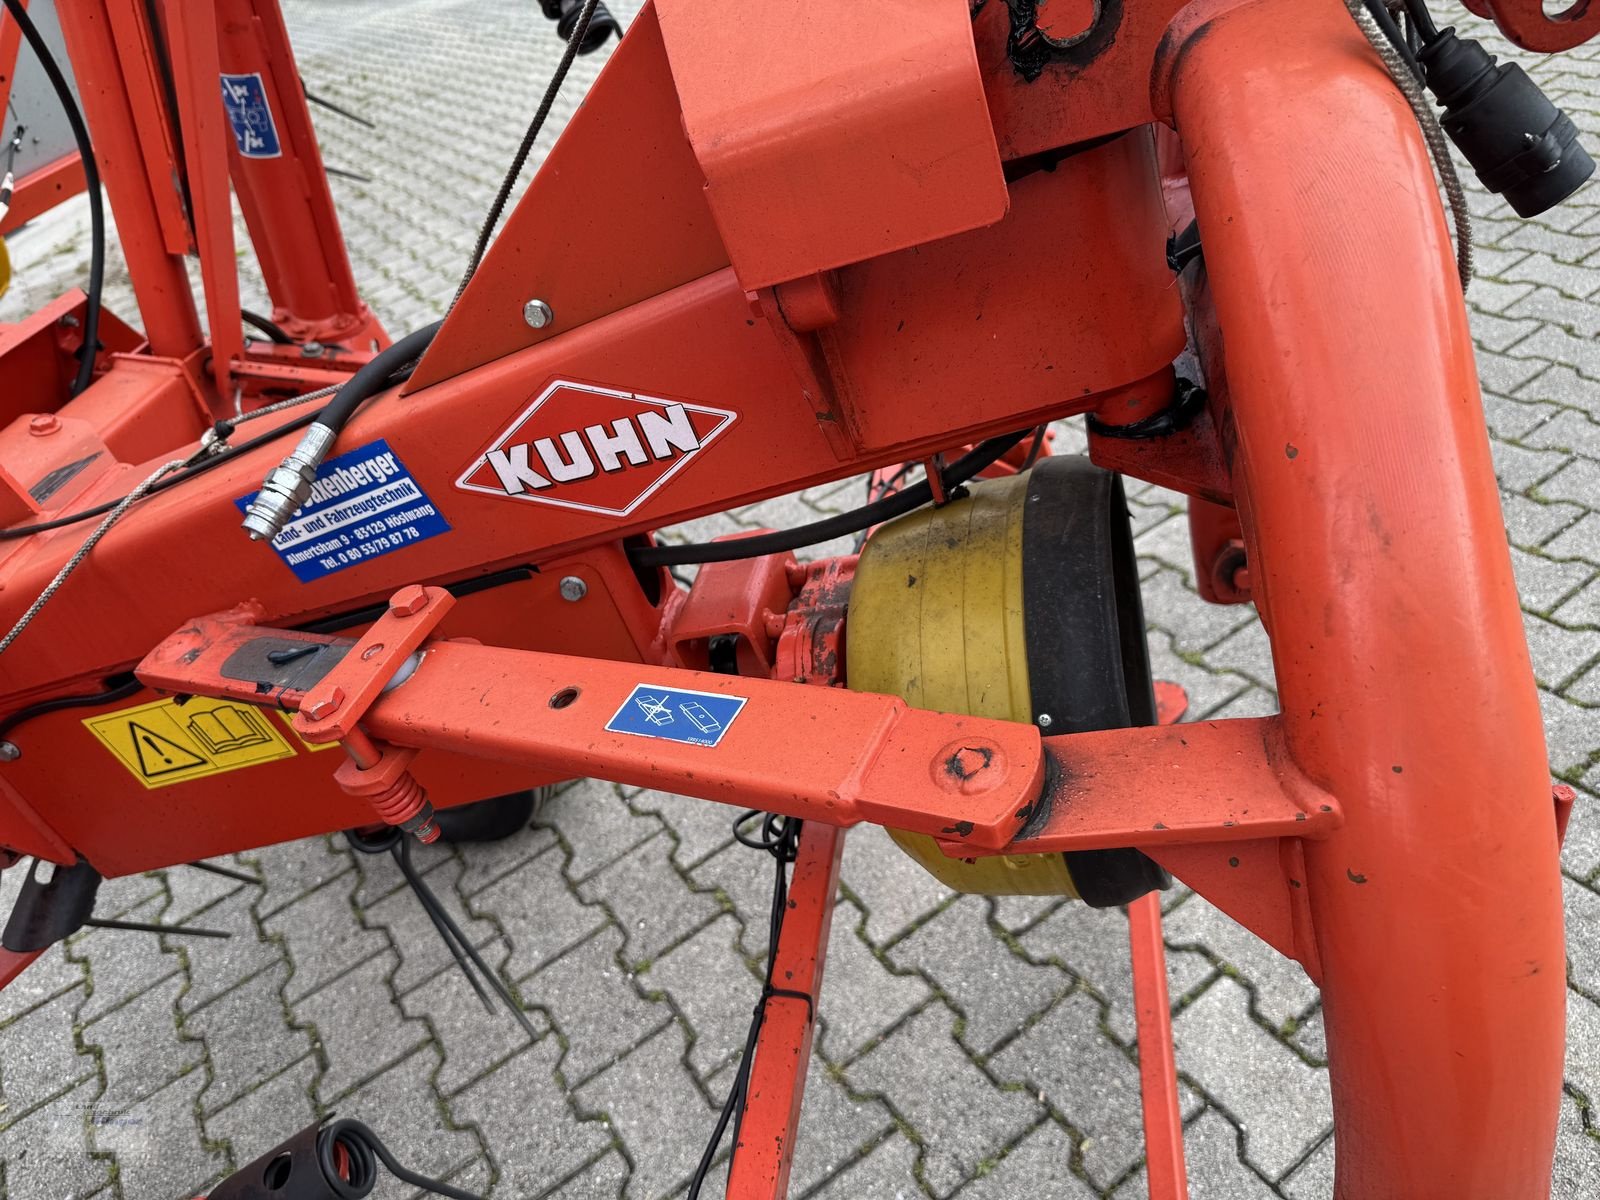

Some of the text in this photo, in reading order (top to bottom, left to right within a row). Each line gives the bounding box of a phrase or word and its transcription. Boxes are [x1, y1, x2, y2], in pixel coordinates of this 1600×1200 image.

[485, 403, 700, 495] KUHN
[274, 482, 416, 546] Land- und Fahrzeugtechnik
[286, 535, 341, 566] Almertsham
[340, 533, 350, 546] 9
[355, 521, 386, 541] 83129
[387, 503, 436, 529] Höslwang
[320, 527, 420, 570] Tel. 0 80 53/79 87 78
